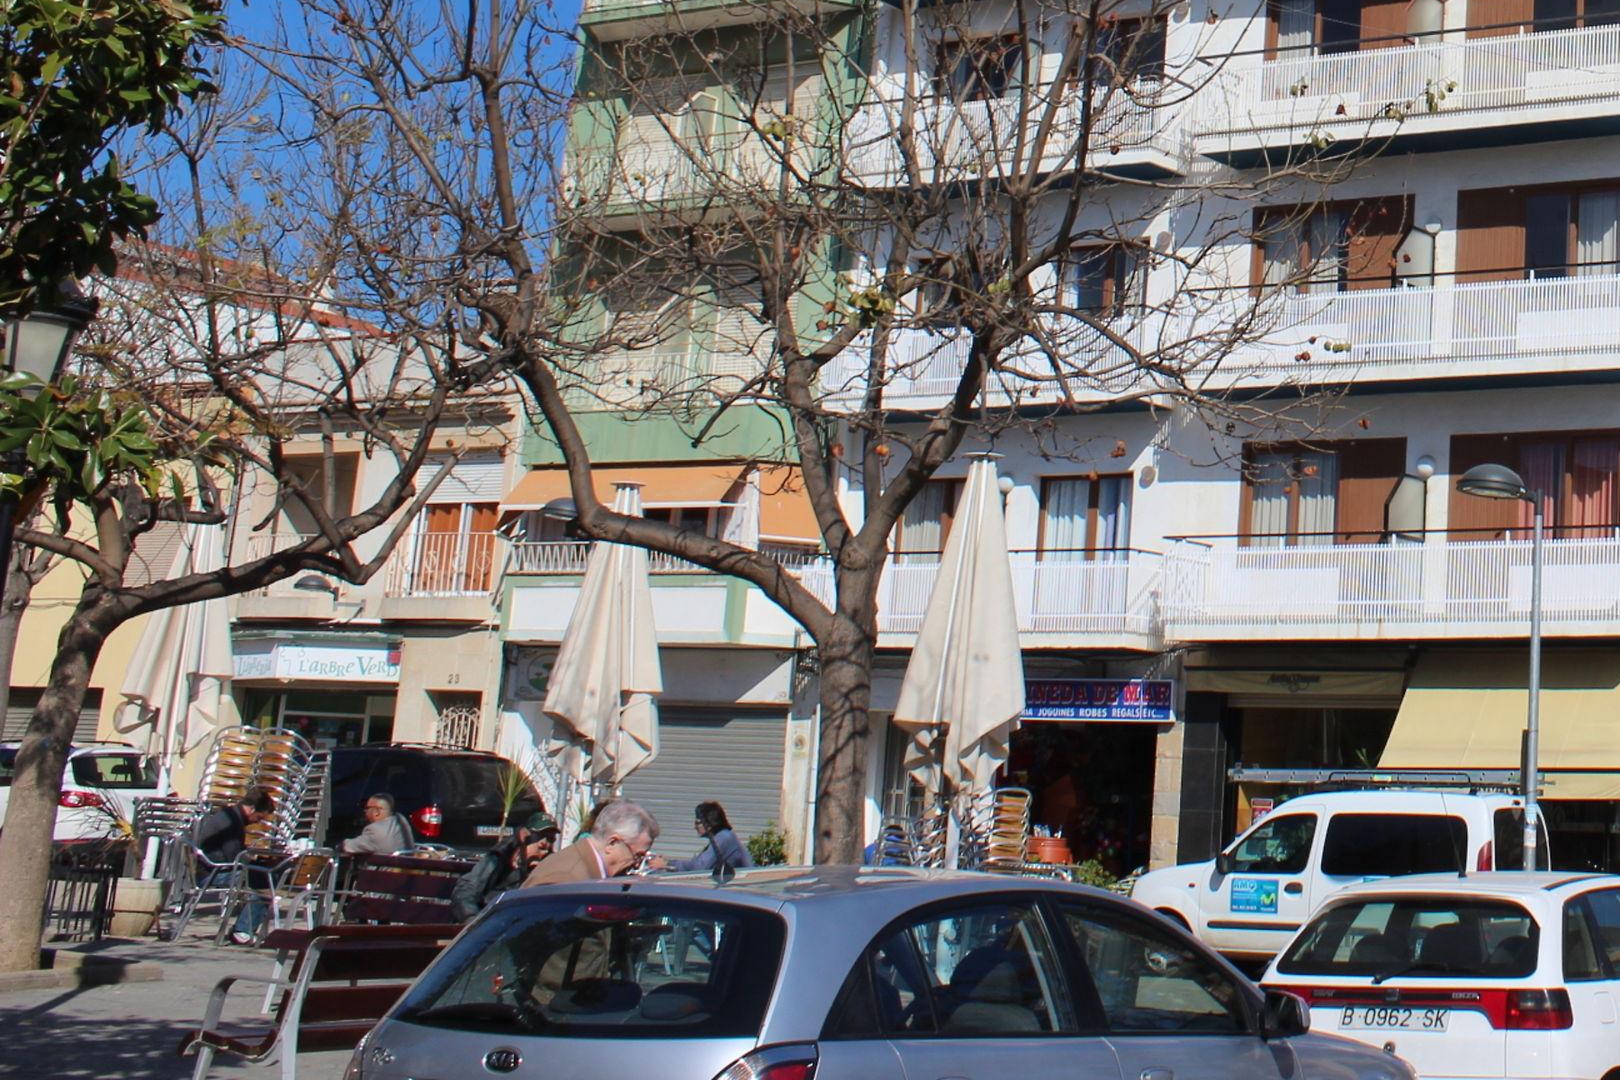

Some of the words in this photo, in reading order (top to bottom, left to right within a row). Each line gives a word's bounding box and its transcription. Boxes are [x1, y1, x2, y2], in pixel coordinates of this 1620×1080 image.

[448, 674, 460, 684] 23
[1026, 684, 1089, 705] INEDA
[1093, 684, 1119, 705] DE
[1122, 684, 1170, 706] MAR
[1038, 707, 1075, 717] JOGUINES
[1079, 708, 1107, 717] ROBES
[1111, 708, 1140, 718] REGALS
[1364, 1007, 1413, 1028] 0962
[1422, 1009, 1448, 1029] SK
